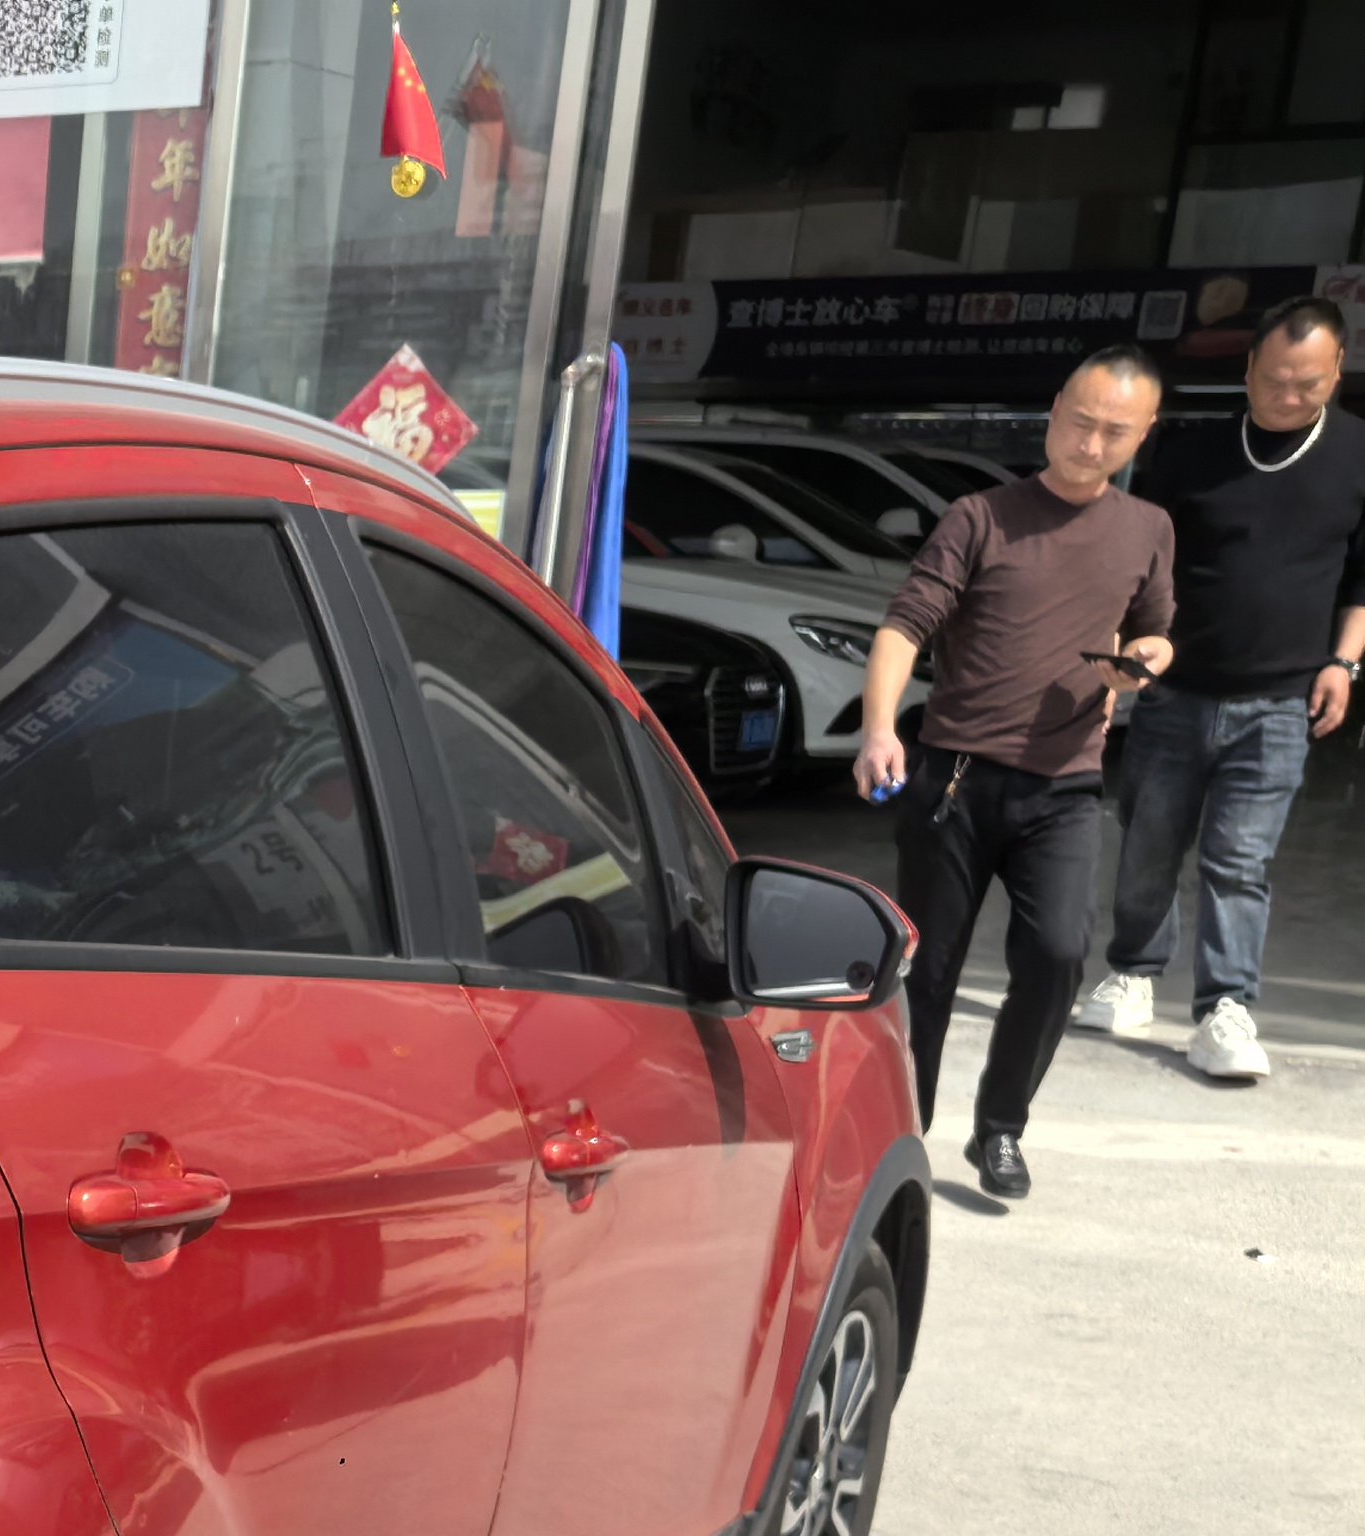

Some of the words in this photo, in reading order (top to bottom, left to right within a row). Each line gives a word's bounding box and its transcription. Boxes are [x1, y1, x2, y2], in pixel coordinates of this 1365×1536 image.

[94, 0, 114, 68] 单检测
[135, 109, 200, 374] 年如意
